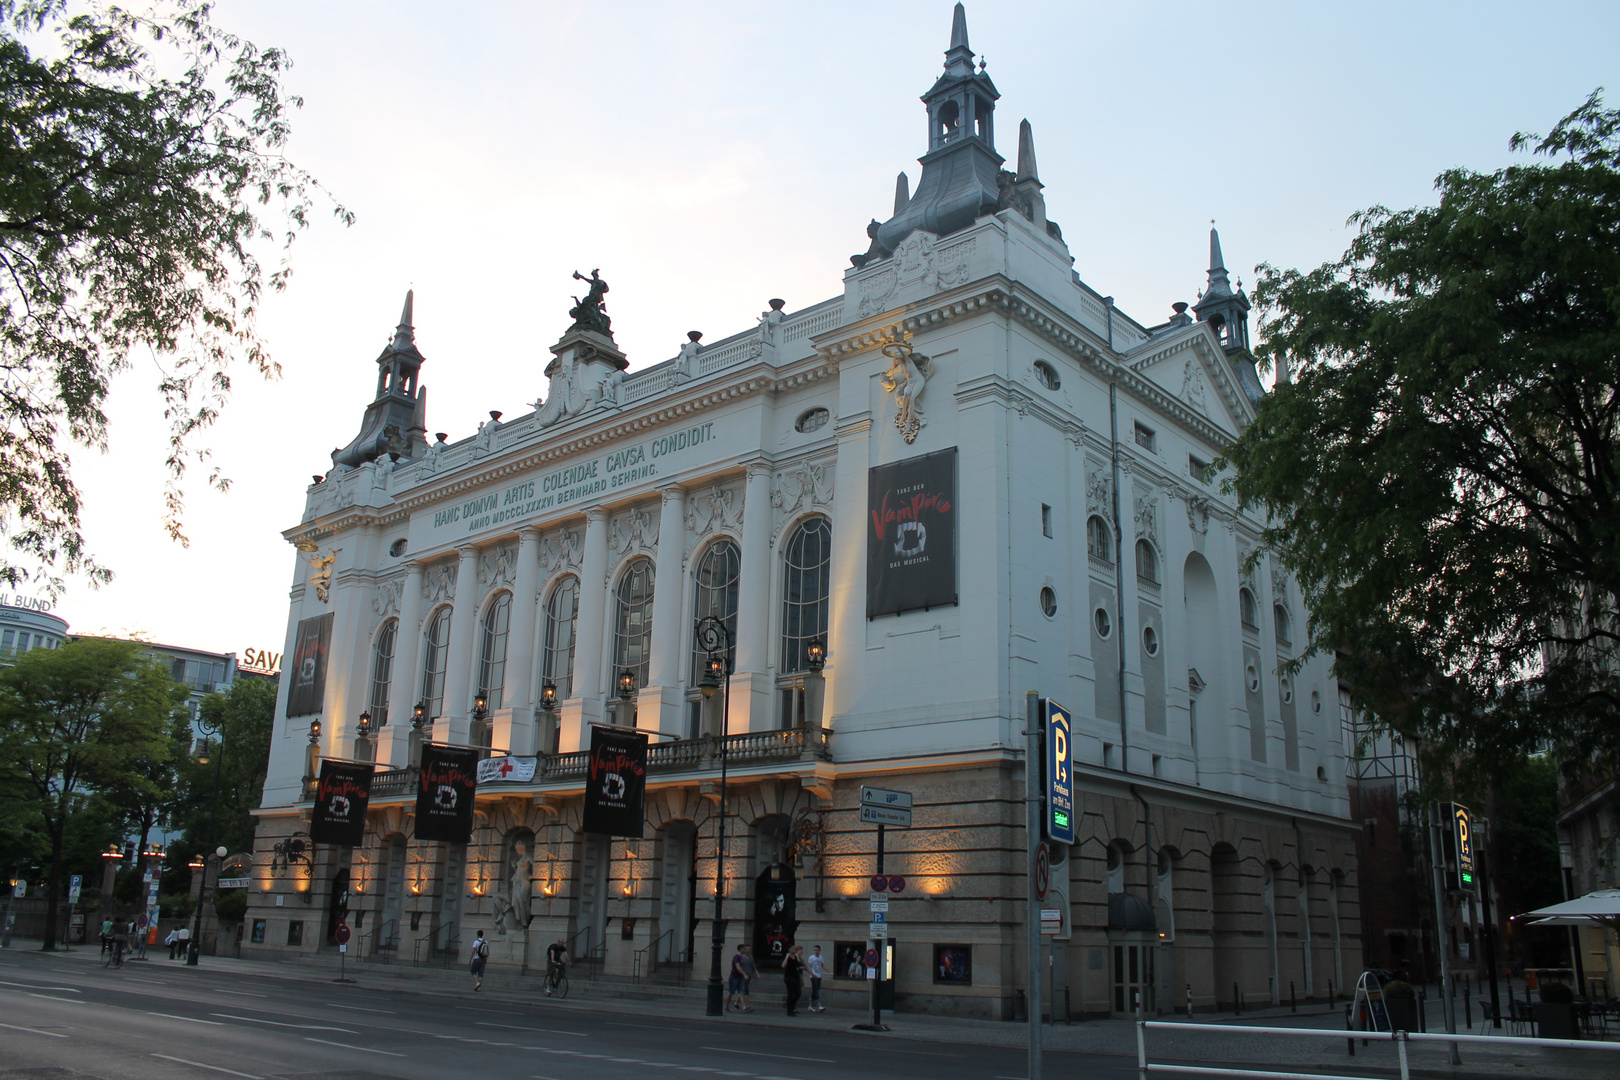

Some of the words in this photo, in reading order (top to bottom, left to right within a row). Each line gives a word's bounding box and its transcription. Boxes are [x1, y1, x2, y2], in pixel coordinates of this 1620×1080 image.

[434, 506, 460, 528] HANC
[462, 493, 498, 519] DOMVM
[504, 481, 535, 506] ARTIS
[543, 460, 598, 493] COLENDAE
[606, 445, 645, 472] CAVSA
[651, 422, 716, 458] CONDIDIT.
[468, 516, 490, 532] ANNO
[558, 479, 606, 504] BERNHARD
[611, 464, 658, 488] SEHRING.
[896, 486, 910, 495] TANZ
[904, 556, 930, 566] MUSICAL
[15, 595, 51, 611] BUND
[244, 647, 284, 670] SAV
[1056, 727, 1067, 780] P
